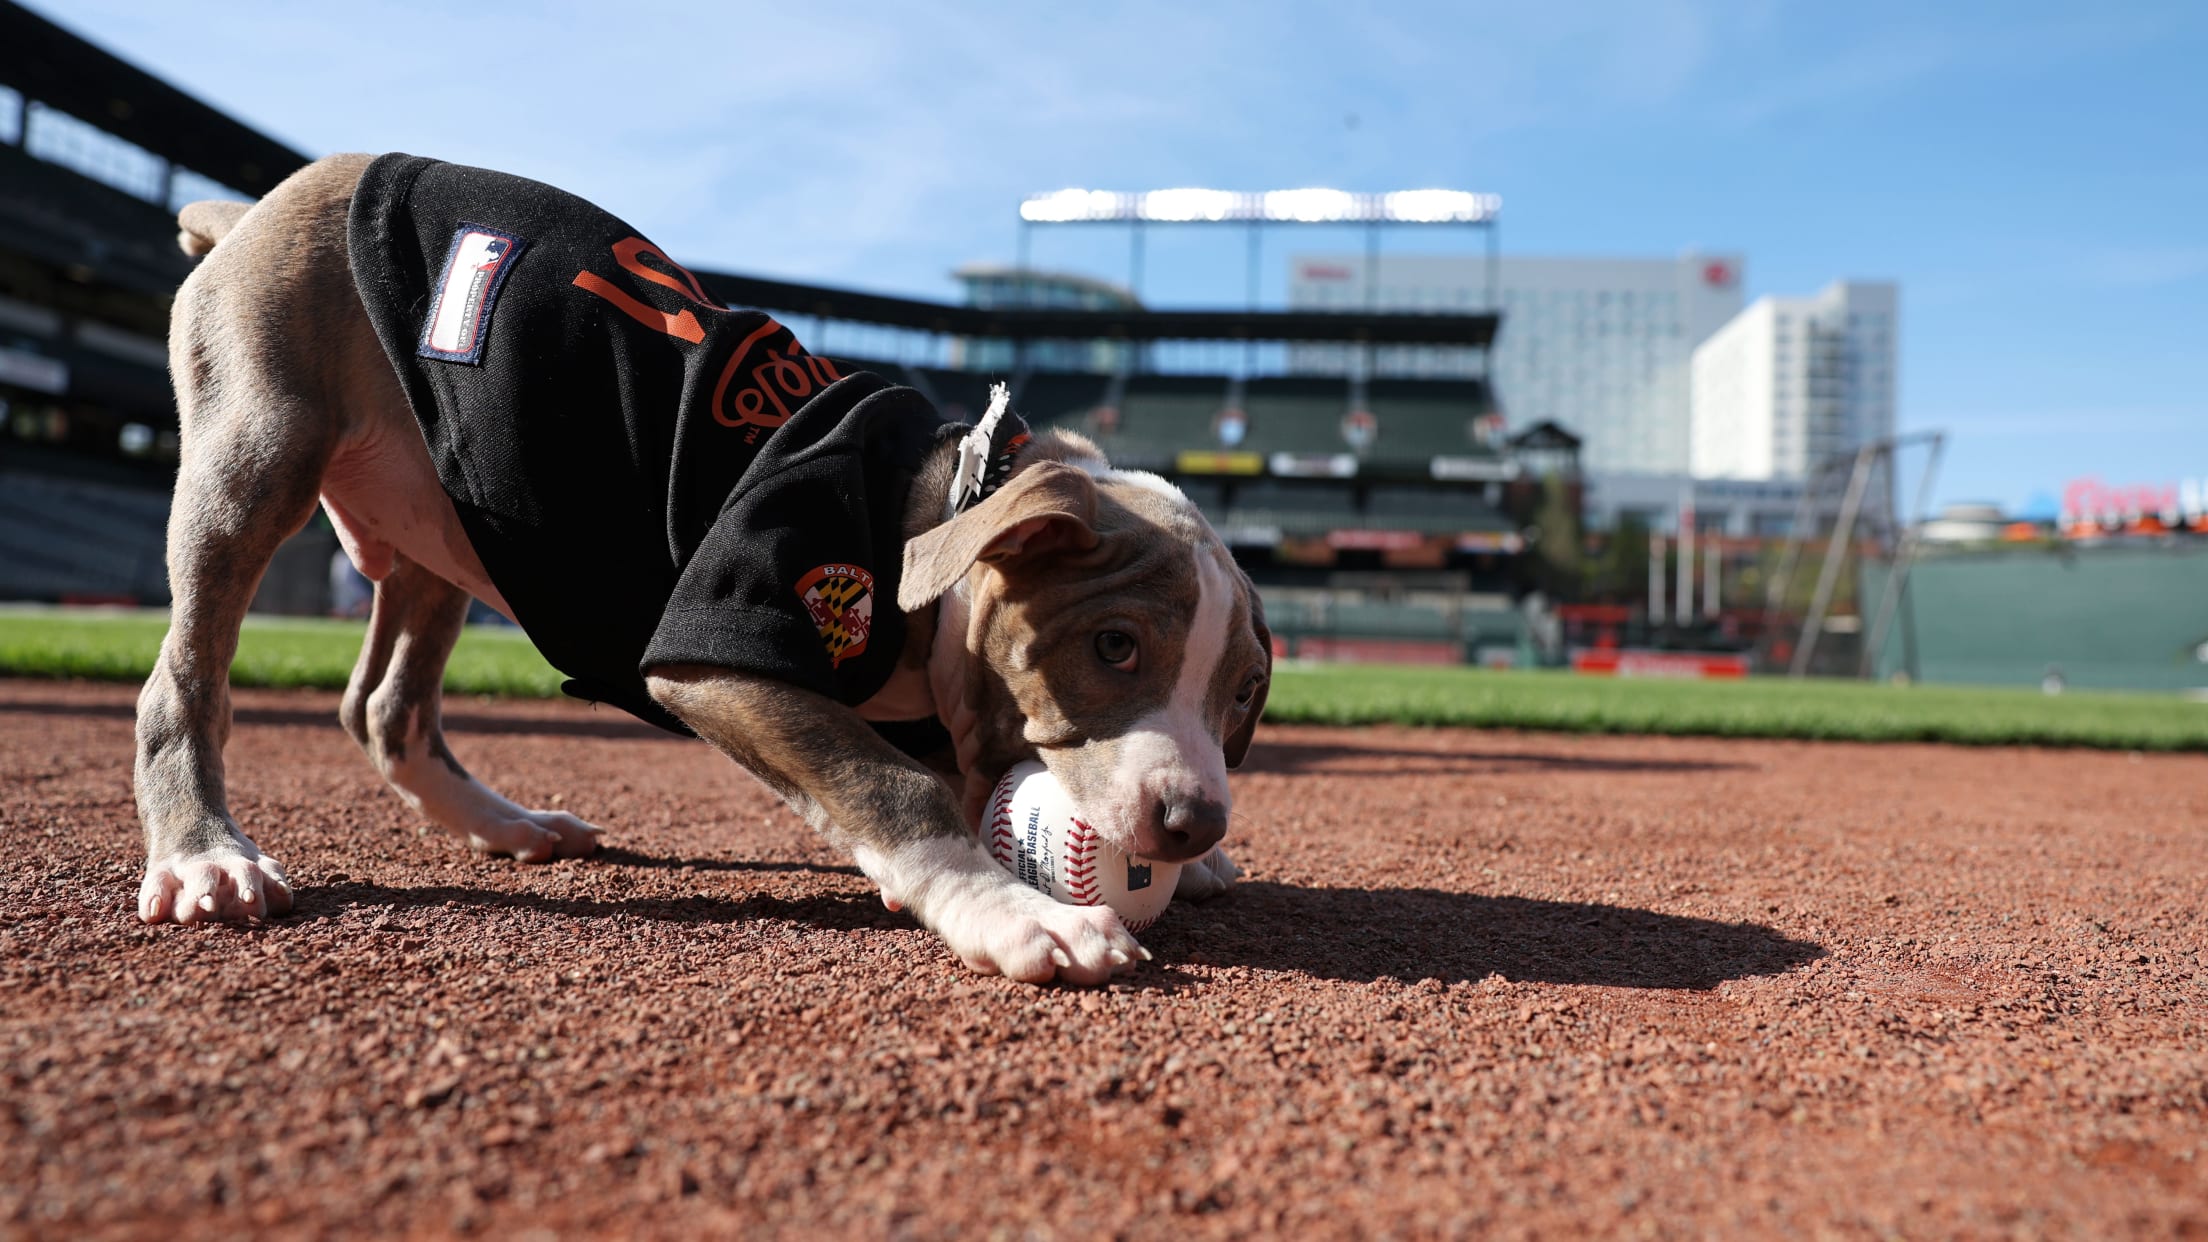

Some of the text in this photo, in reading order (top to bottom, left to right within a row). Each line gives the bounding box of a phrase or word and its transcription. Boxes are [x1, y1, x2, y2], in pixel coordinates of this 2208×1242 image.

[462, 271, 485, 326] PROPERTY
[744, 426, 760, 445] TM
[1026, 806, 1041, 856] BASEBALL
[1018, 848, 1028, 883] FFICIAL
